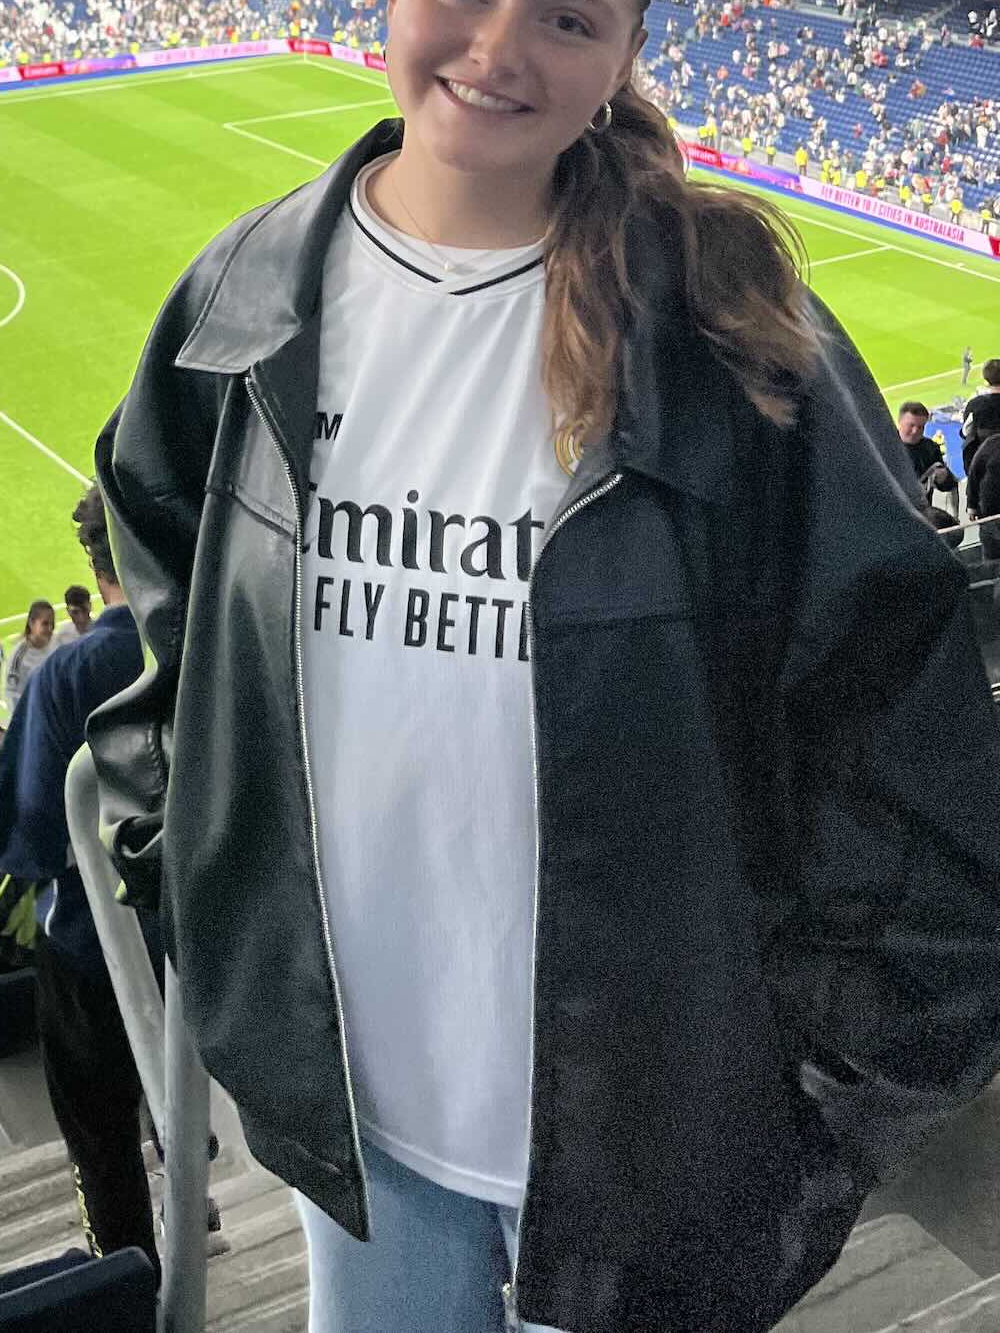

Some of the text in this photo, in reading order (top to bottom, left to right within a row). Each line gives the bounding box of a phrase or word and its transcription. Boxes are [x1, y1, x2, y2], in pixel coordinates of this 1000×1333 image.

[833, 188, 861, 207] BETTER
[862, 198, 871, 211] TO
[878, 203, 902, 220] CITIES
[904, 211, 913, 224] IN
[915, 216, 965, 243] AUSTRALASIA
[303, 482, 546, 583] mirat
[313, 576, 530, 663] FLY BETT
